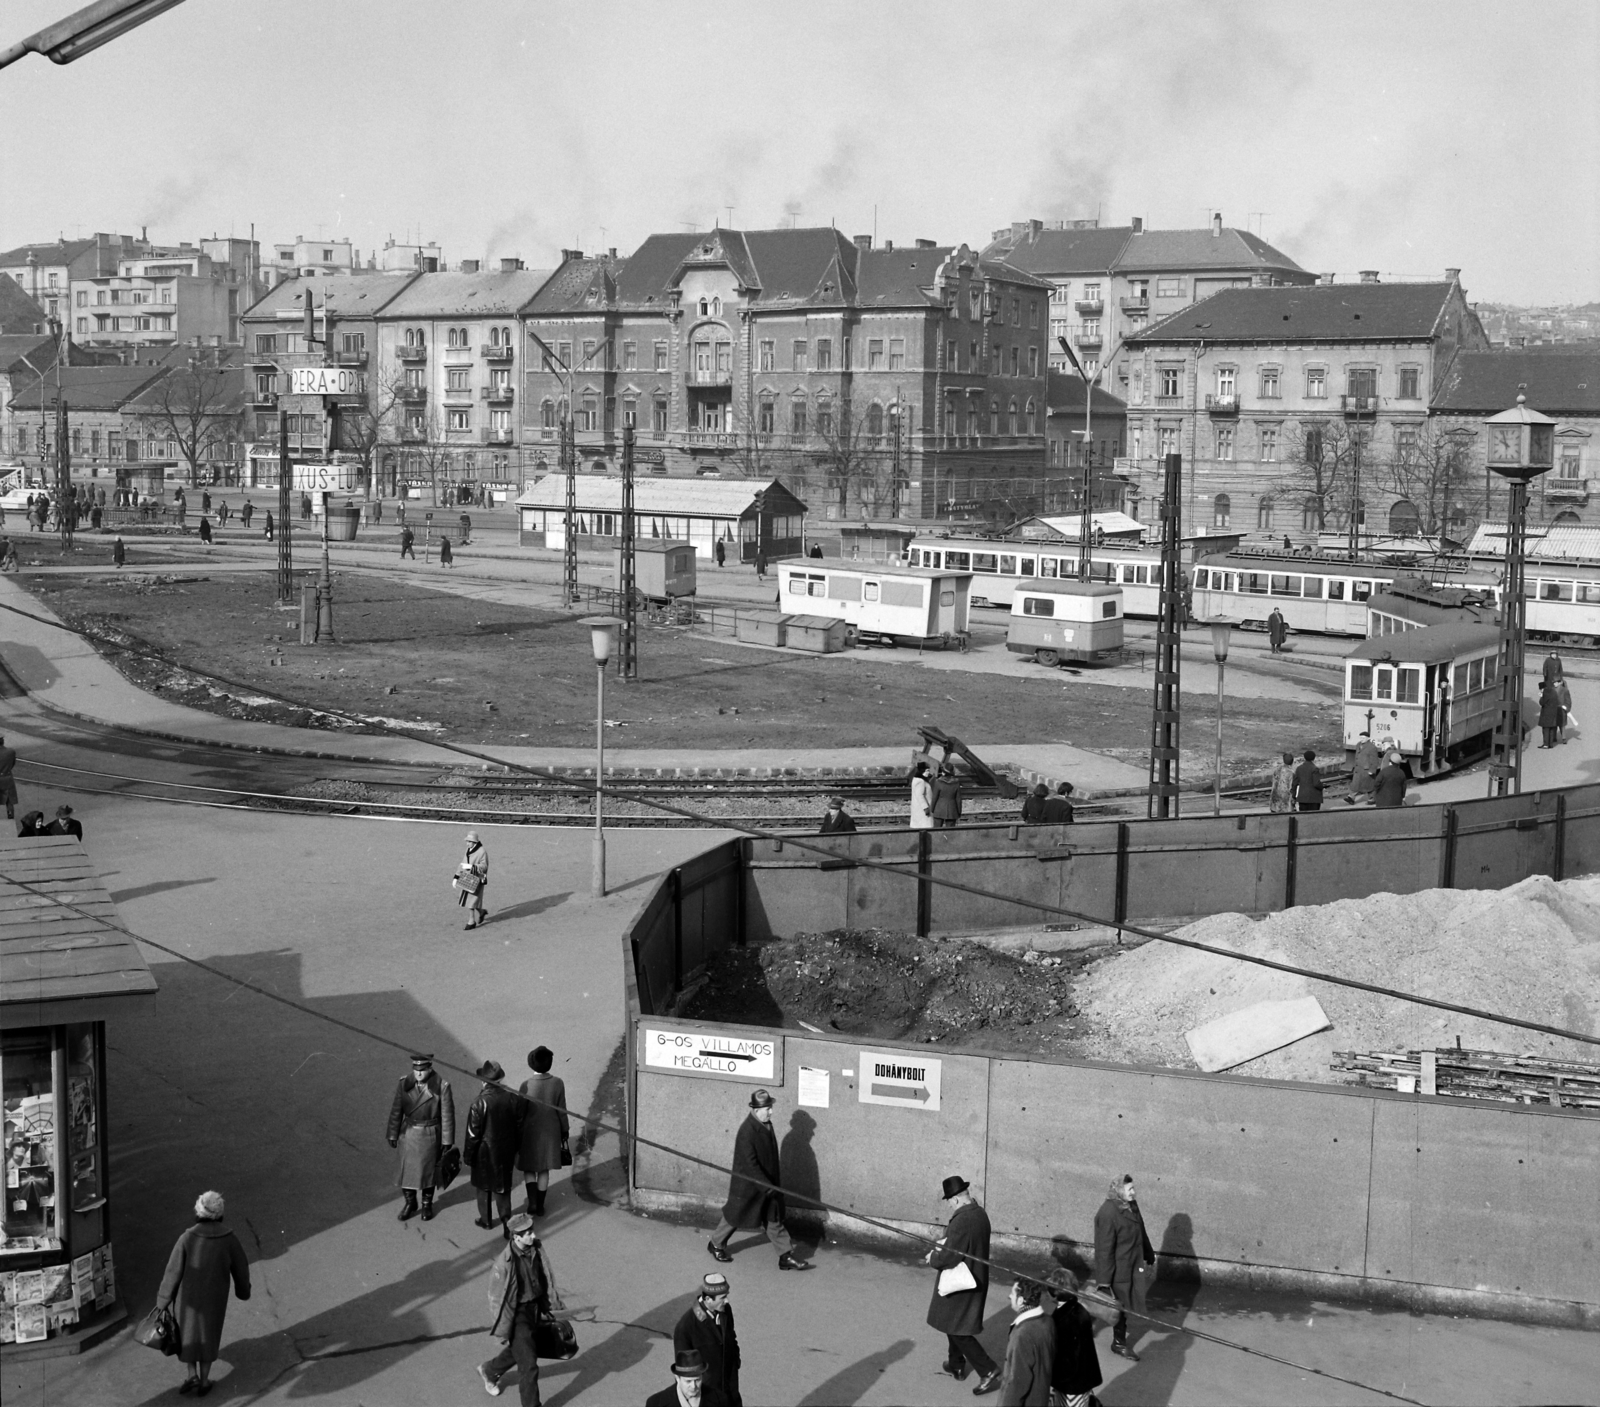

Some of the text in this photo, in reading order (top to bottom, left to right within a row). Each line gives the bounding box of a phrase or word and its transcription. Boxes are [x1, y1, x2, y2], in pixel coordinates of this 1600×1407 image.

[657, 1034, 772, 1056] 6-OS VILLAMOS
[874, 1063, 926, 1082] DOHÁNYBOLT
